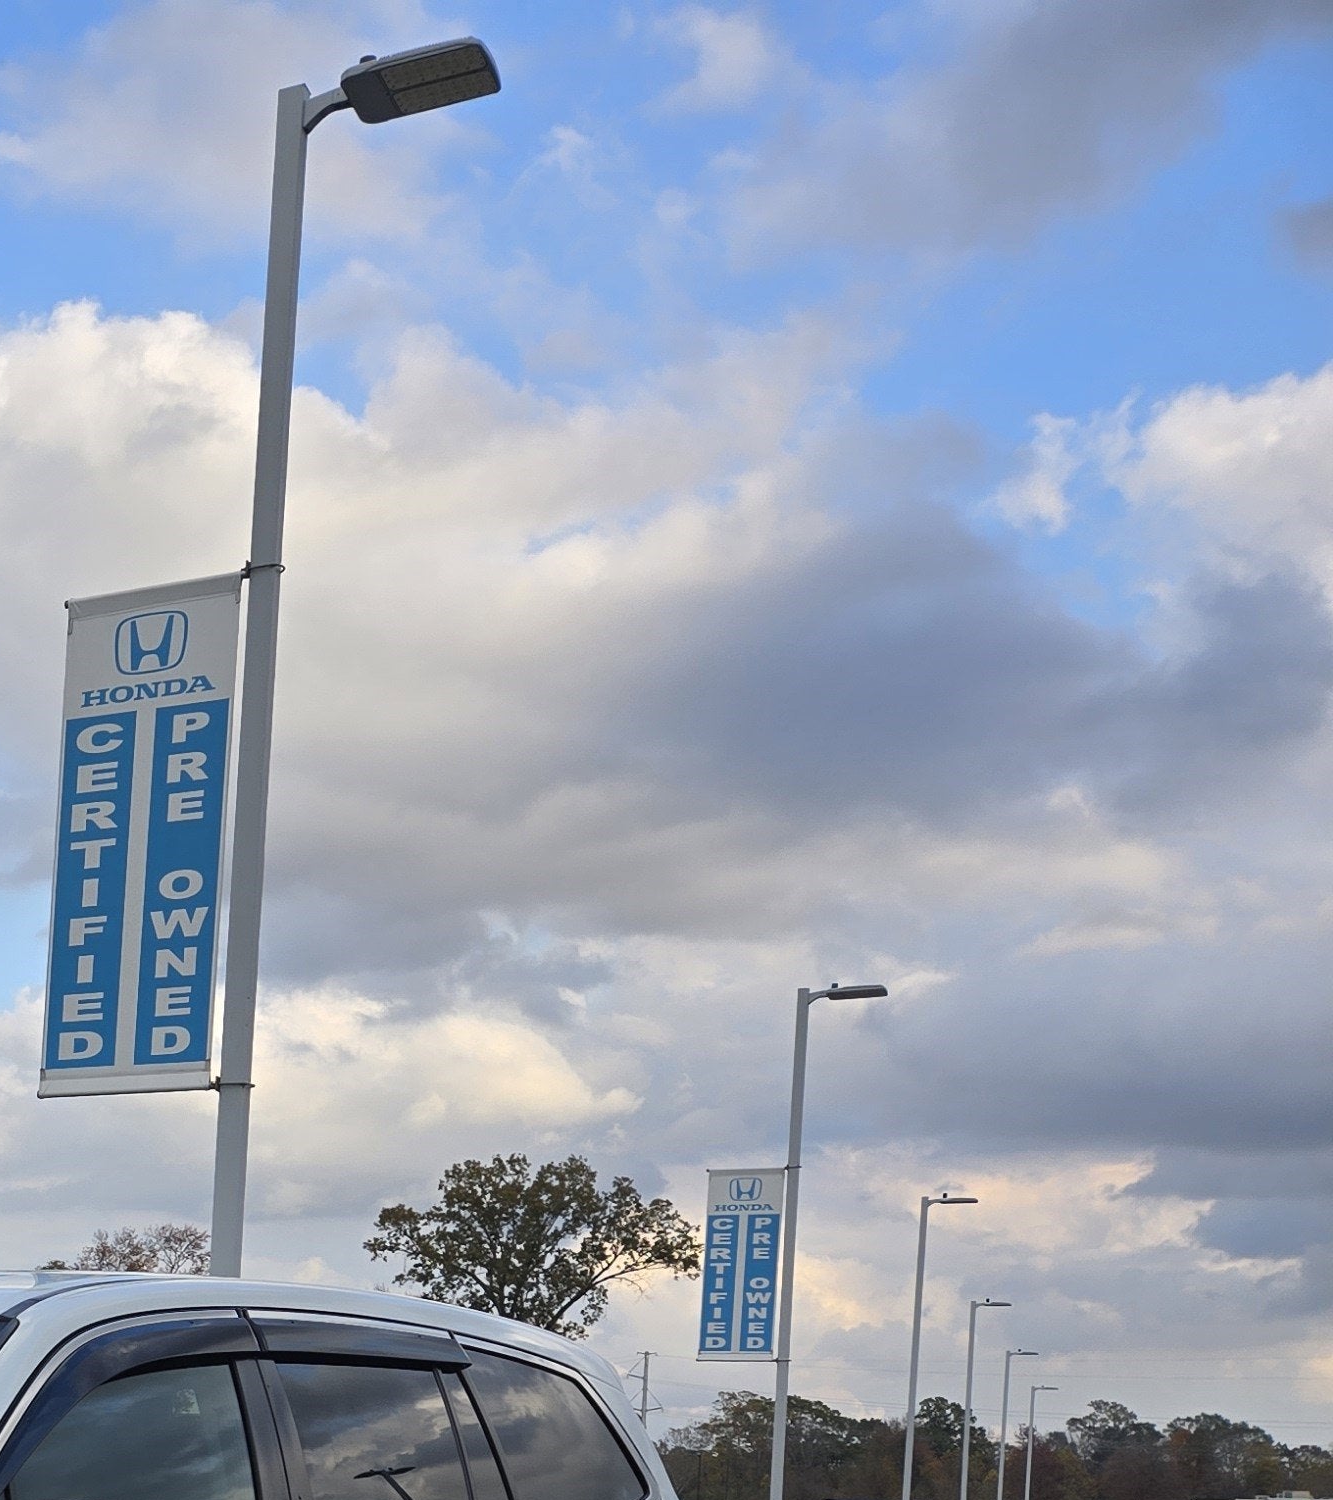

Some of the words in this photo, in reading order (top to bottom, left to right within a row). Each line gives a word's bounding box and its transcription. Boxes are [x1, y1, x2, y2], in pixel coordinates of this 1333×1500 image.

[80, 675, 217, 708] HONDA
[166, 711, 210, 823] PRE
[57, 723, 125, 1062] CERTIFIED
[150, 868, 209, 1057] OWNED
[714, 1203, 774, 1212] HONDA
[752, 1217, 773, 1260] PRE
[705, 1218, 734, 1349] CERTIFIED
[746, 1277, 773, 1349] OWNED
